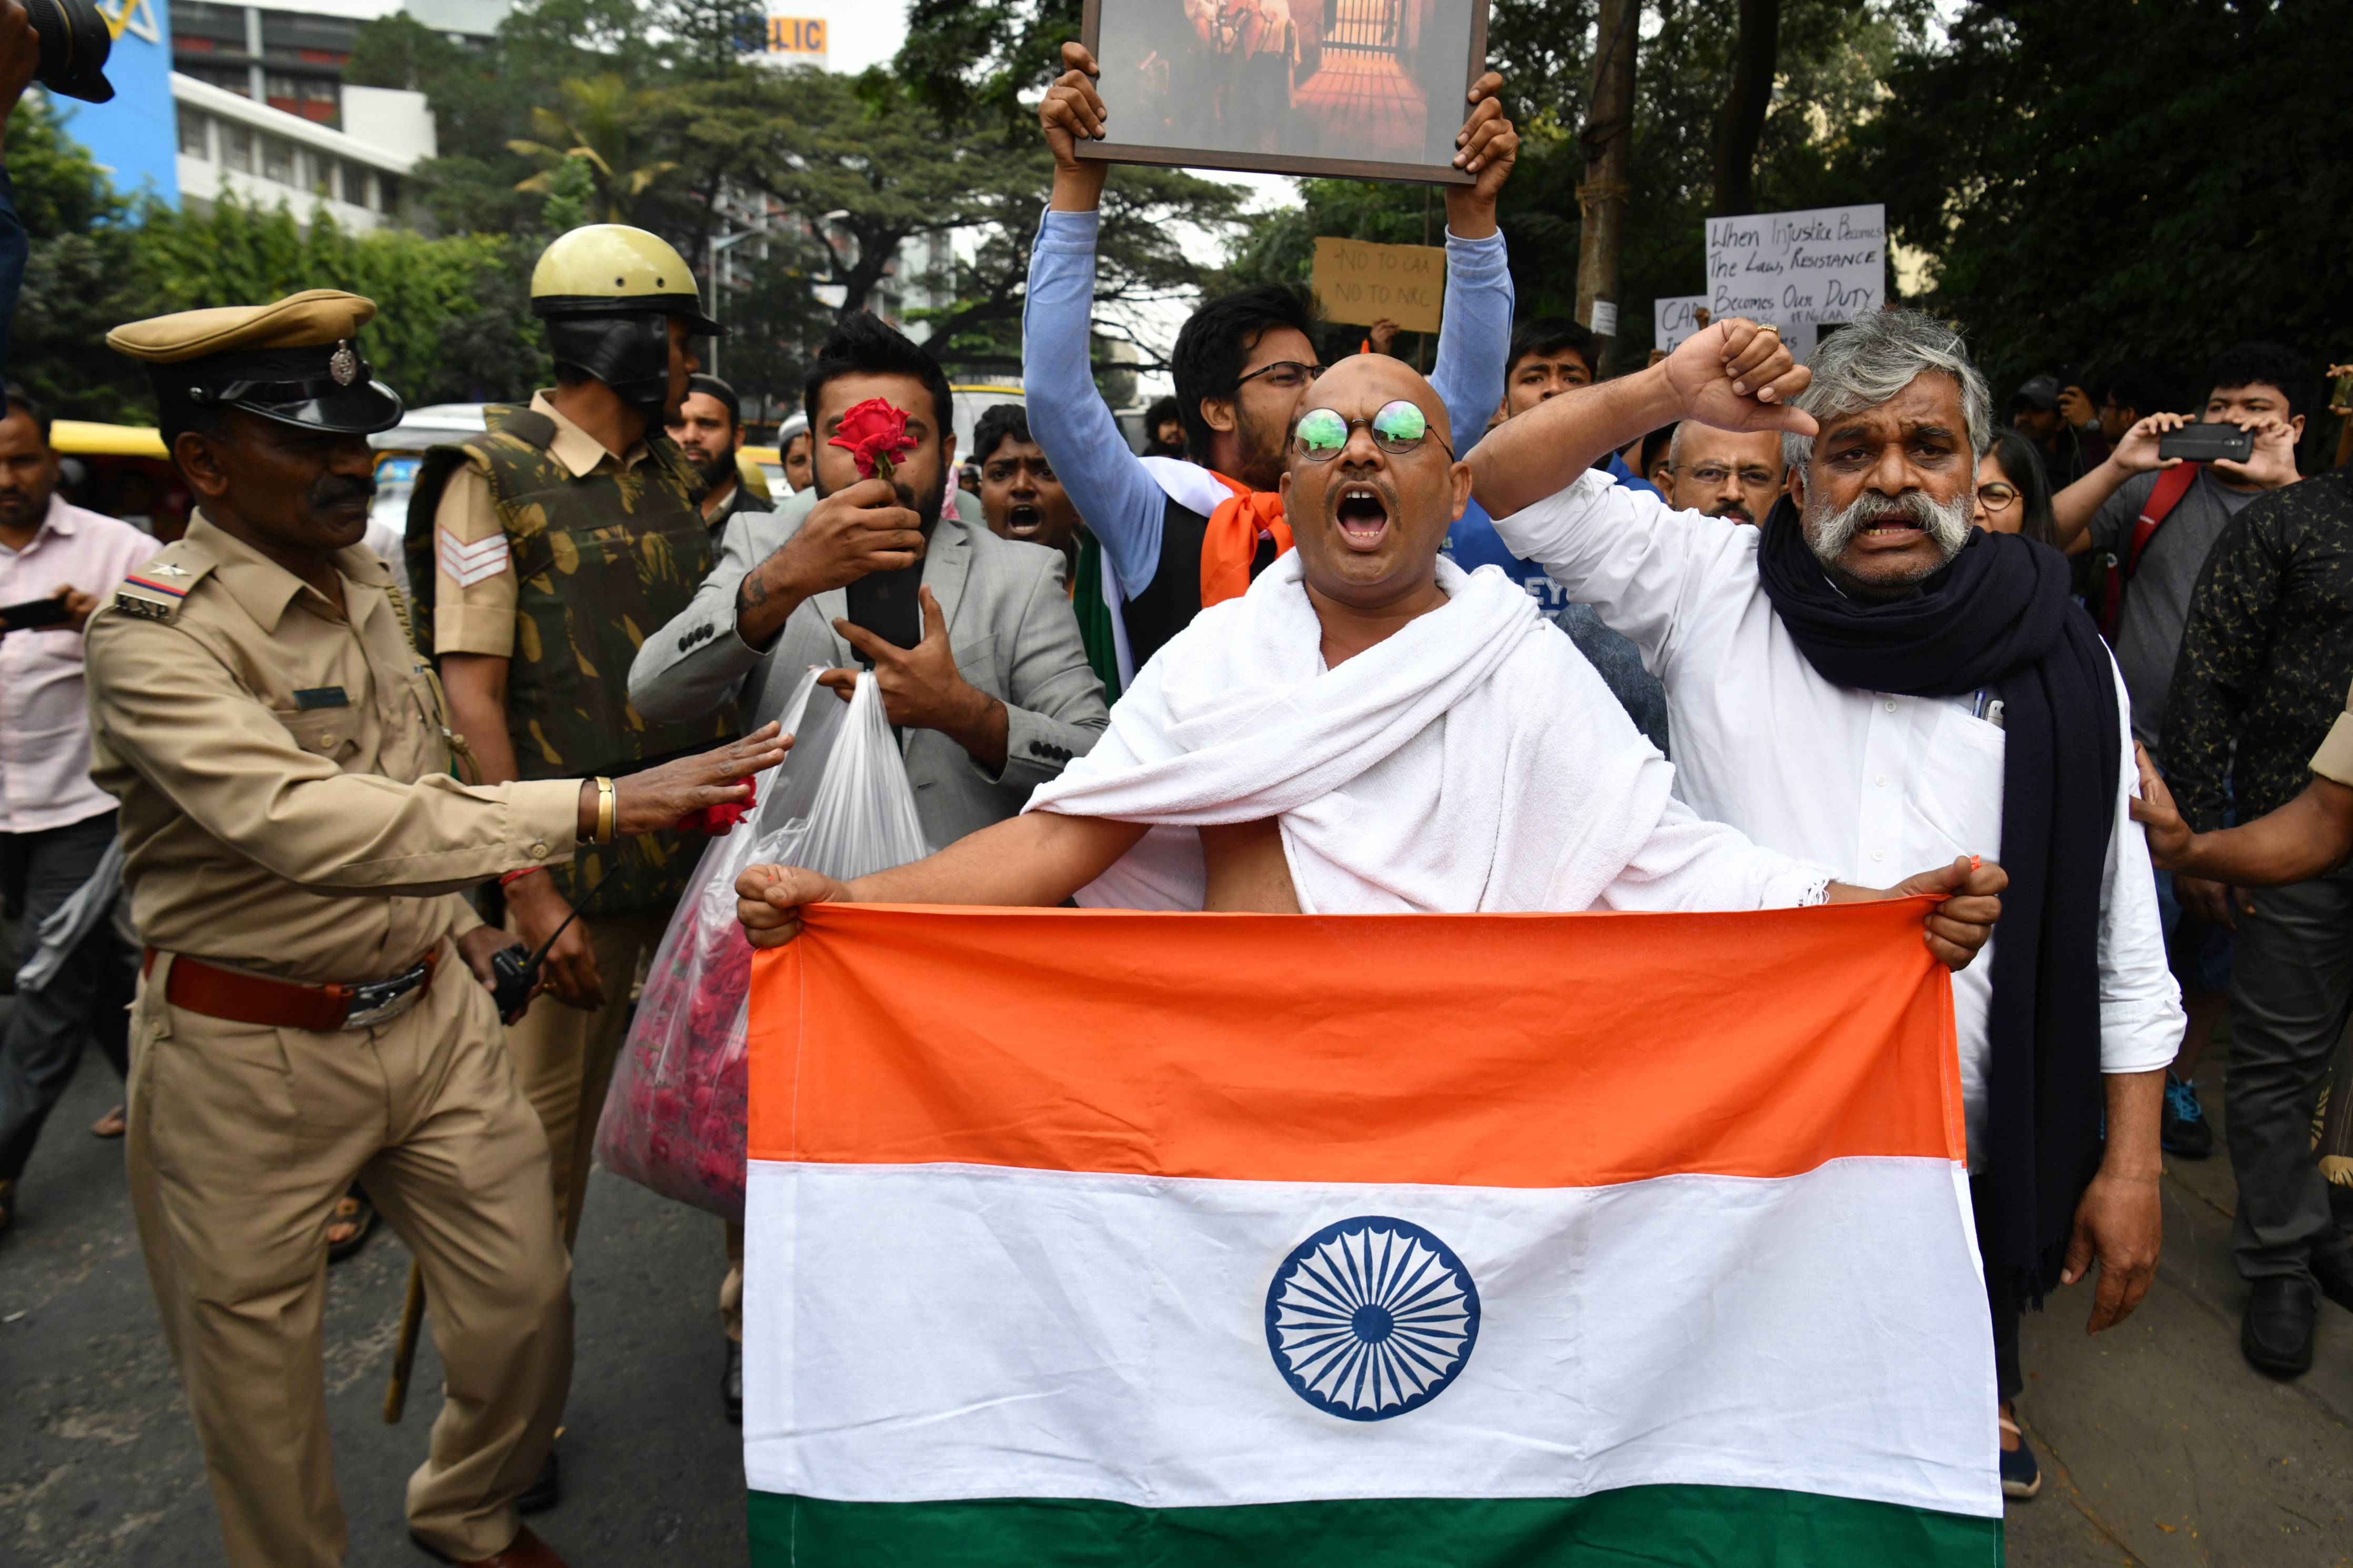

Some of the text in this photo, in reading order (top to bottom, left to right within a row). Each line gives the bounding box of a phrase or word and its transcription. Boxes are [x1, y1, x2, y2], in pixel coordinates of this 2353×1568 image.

[774, 20, 821, 50] LIC
[1712, 221, 1759, 248] When
[1771, 216, 1832, 256] Injustice
[1377, 252, 1397, 269] TO
[1710, 250, 1737, 277] The
[1745, 250, 1783, 276] Law,
[1334, 282, 1362, 302] NO
[1368, 285, 1390, 304] TO
[1714, 285, 1775, 313] Becomes
